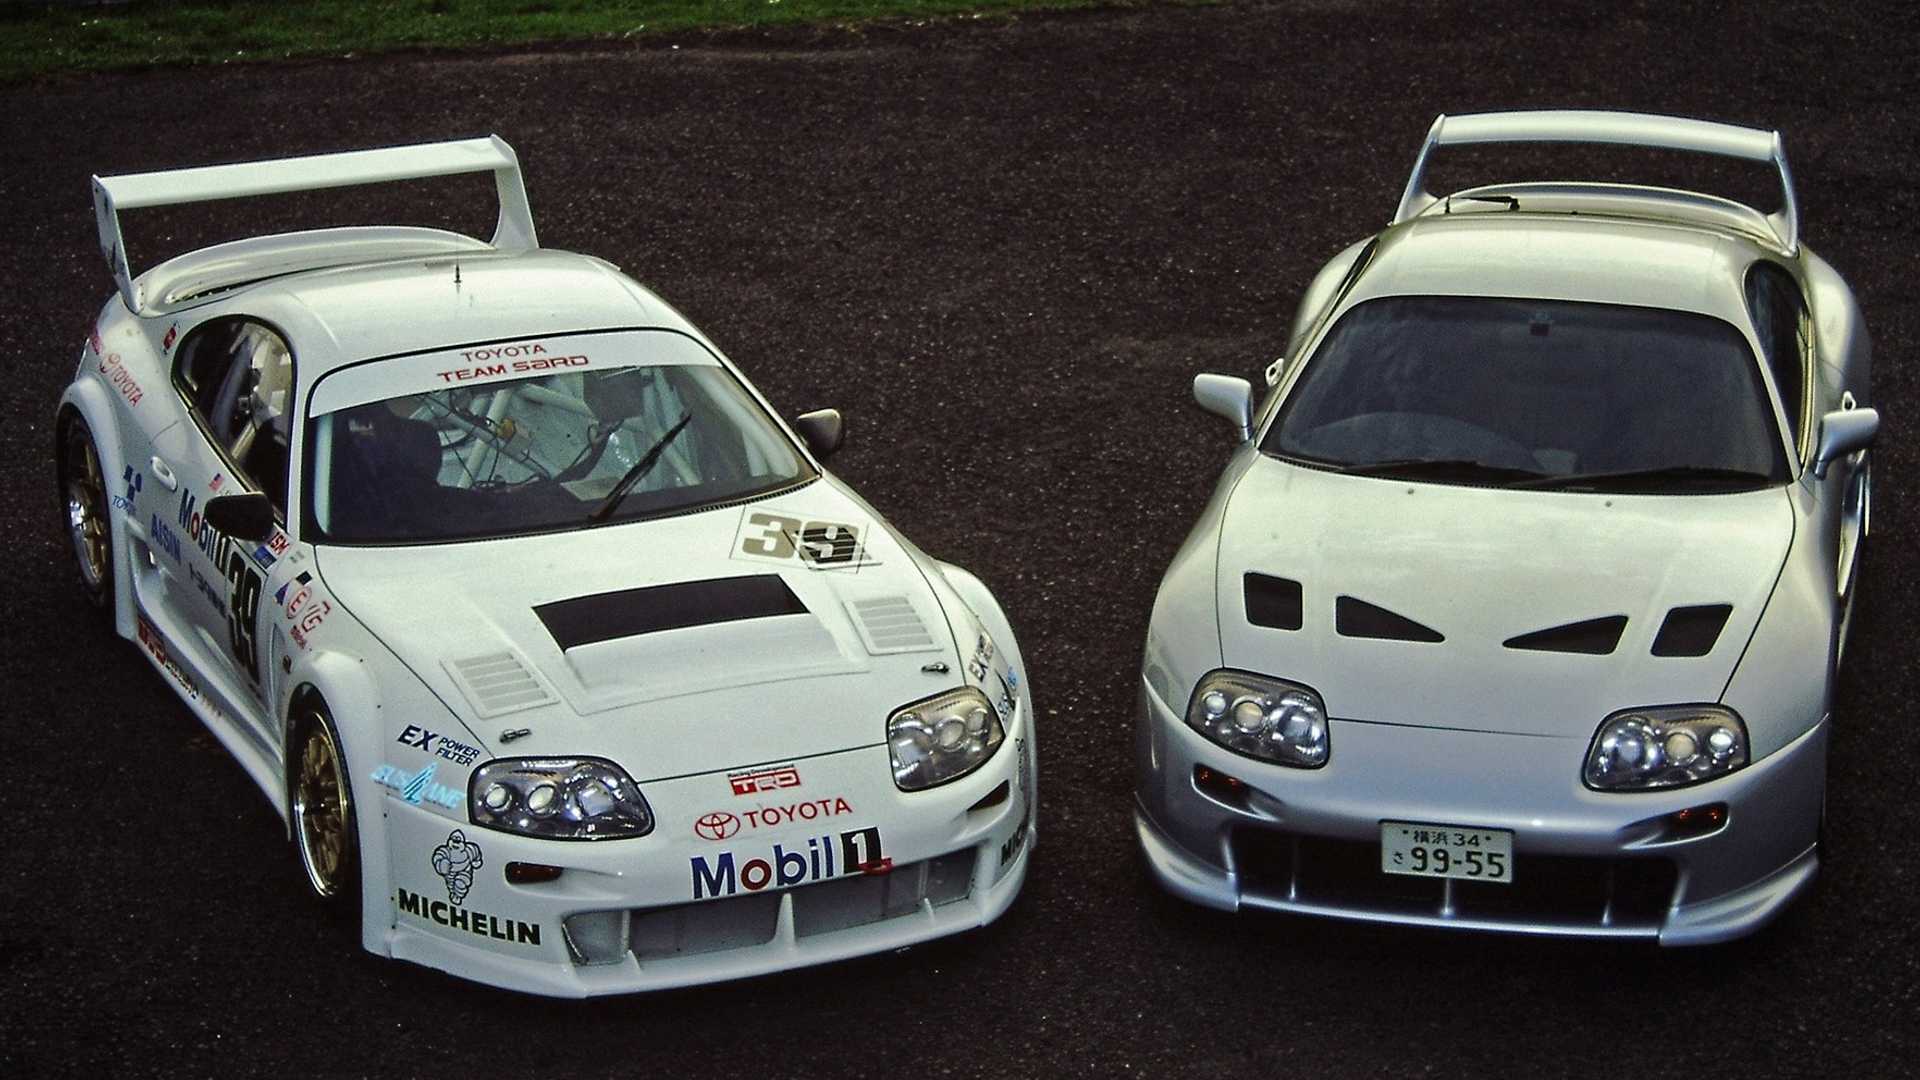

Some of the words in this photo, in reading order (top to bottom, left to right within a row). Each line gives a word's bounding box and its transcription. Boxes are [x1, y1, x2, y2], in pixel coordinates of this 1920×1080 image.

[460, 344, 547, 362] TOYOTA
[112, 365, 144, 407] TOYOTA
[437, 364, 507, 382] TEAM
[151, 512, 182, 567] AISIN
[742, 512, 860, 564] 39
[397, 725, 439, 752] EX
[438, 737, 480, 759] POWER
[434, 748, 474, 767] FILTER
[732, 771, 799, 793] TRD
[743, 798, 853, 828] TOYOTA
[1413, 830, 1448, 846] 横浜
[1453, 833, 1481, 847] 34
[690, 836, 834, 900] Mobil
[1392, 850, 1404, 865] さ
[1410, 847, 1505, 878] 99-55
[398, 887, 541, 946] MICHELIN
